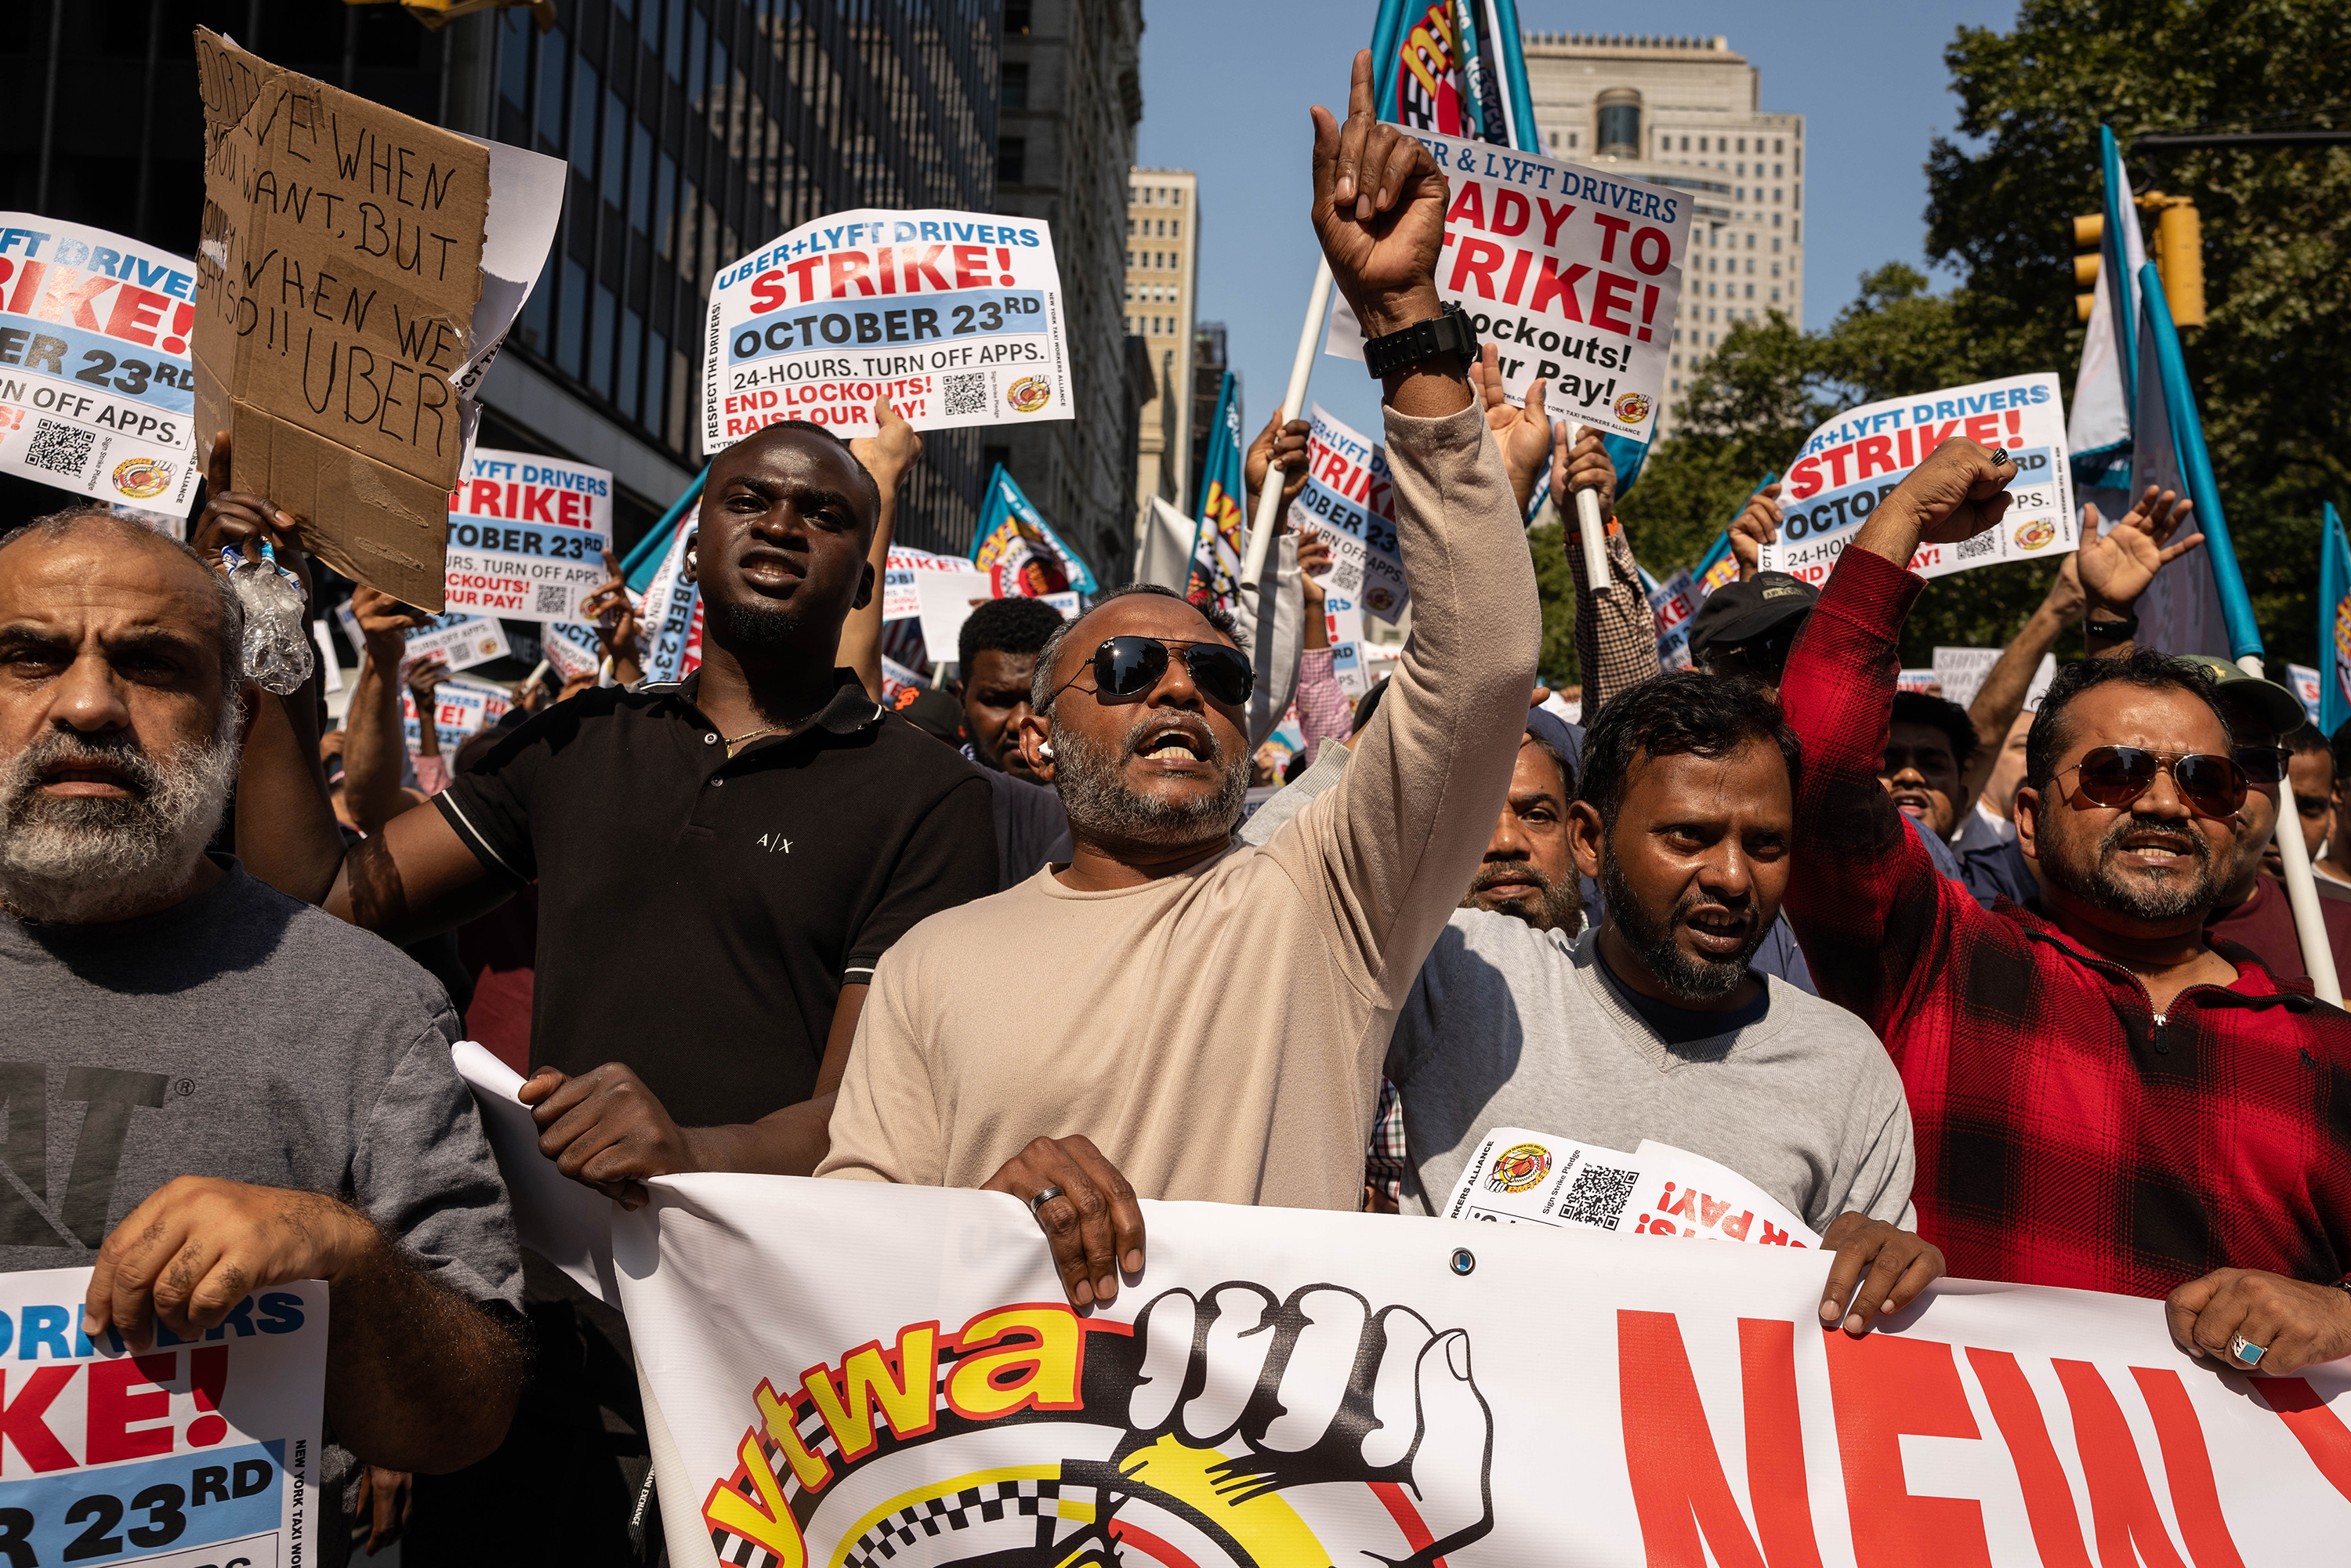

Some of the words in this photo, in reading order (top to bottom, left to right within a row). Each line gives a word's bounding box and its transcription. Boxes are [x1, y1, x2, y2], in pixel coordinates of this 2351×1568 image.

[201, 40, 314, 164] DRIVE
[332, 113, 456, 211] WHEN
[1457, 148, 1476, 173] &
[1483, 153, 1555, 190] LYFT
[1561, 171, 1678, 224] DRIVERS
[243, 154, 346, 239] WANT,
[354, 202, 458, 281] BUT
[1443, 174, 1577, 248] ADY
[1594, 212, 1671, 276] TO
[0, 227, 52, 257] FT
[53, 237, 197, 302] DRIVE
[718, 222, 885, 291] UBER+LYFT
[893, 221, 1040, 248] DRIVERS
[749, 244, 1016, 314] STRIKE!
[393, 304, 454, 373] WE
[709, 301, 722, 353] DRIVERS!
[734, 308, 942, 359] OCTOBER
[951, 297, 1040, 335] 23RD
[1455, 299, 1632, 373] ockouts!
[707, 357, 718, 381] THE
[734, 358, 859, 390] 24-HOURS.
[863, 354, 924, 377] TURN
[931, 346, 973, 369] OFF
[979, 342, 1045, 364] APPS.
[1054, 342, 1063, 373] WORKERS
[302, 327, 448, 458] UBER
[725, 390, 778, 415] END
[1058, 375, 1067, 407] ALLIANCE
[1536, 359, 1617, 408] Pay!
[0, 378, 27, 402] N
[32, 387, 94, 417] OFF
[95, 404, 182, 446] APPS.
[707, 382, 719, 438] RESPECT
[810, 405, 869, 426] OUR
[874, 399, 926, 424] AY!
[1547, 404, 1564, 415] YORK
[1566, 409, 1580, 419] TAXI
[1581, 414, 1610, 427] WORKERS
[1610, 423, 1641, 436] ALLIANCE
[1912, 384, 2052, 425] DRIVERS
[95, 449, 108, 470] Strike
[100, 436, 113, 448] Sign
[189, 448, 197, 465] ERS
[1790, 409, 2024, 500] STRIKE!
[88, 469, 102, 491] Pledge
[176, 467, 193, 505] ALLIANCE
[469, 458, 516, 481] YFT
[522, 465, 608, 498] DRIVERS
[551, 536, 603, 559] 23RD
[1364, 523, 1398, 553] 23
[484, 559, 527, 577] TURN
[532, 564, 562, 578] OFF
[565, 568, 603, 586] APPS.
[1342, 541, 1369, 561] OFF
[1367, 557, 1403, 585] APPS.
[1784, 565, 1824, 583] ND
[446, 573, 531, 594] CKOUTS!
[482, 593, 523, 610] PAY!
[1324, 598, 1352, 614] RS
[755, 832, 794, 854] A/X
[1469, 1140, 1494, 1186] ALLIANCE
[1541, 1198, 1556, 1215] Sign
[1551, 1175, 1567, 1197] Strike
[1561, 1149, 1581, 1175] Pledge
[1656, 1181, 1755, 1243] PAY!
[294, 1439, 306, 1468] NEW
[1616, 1309, 2247, 1568] NEW
[292, 1470, 305, 1508] YORK
[632, 1489, 650, 1526] EXCHANGE
[63, 1458, 273, 1563] 23RD
[292, 1509, 302, 1541] TAXI
